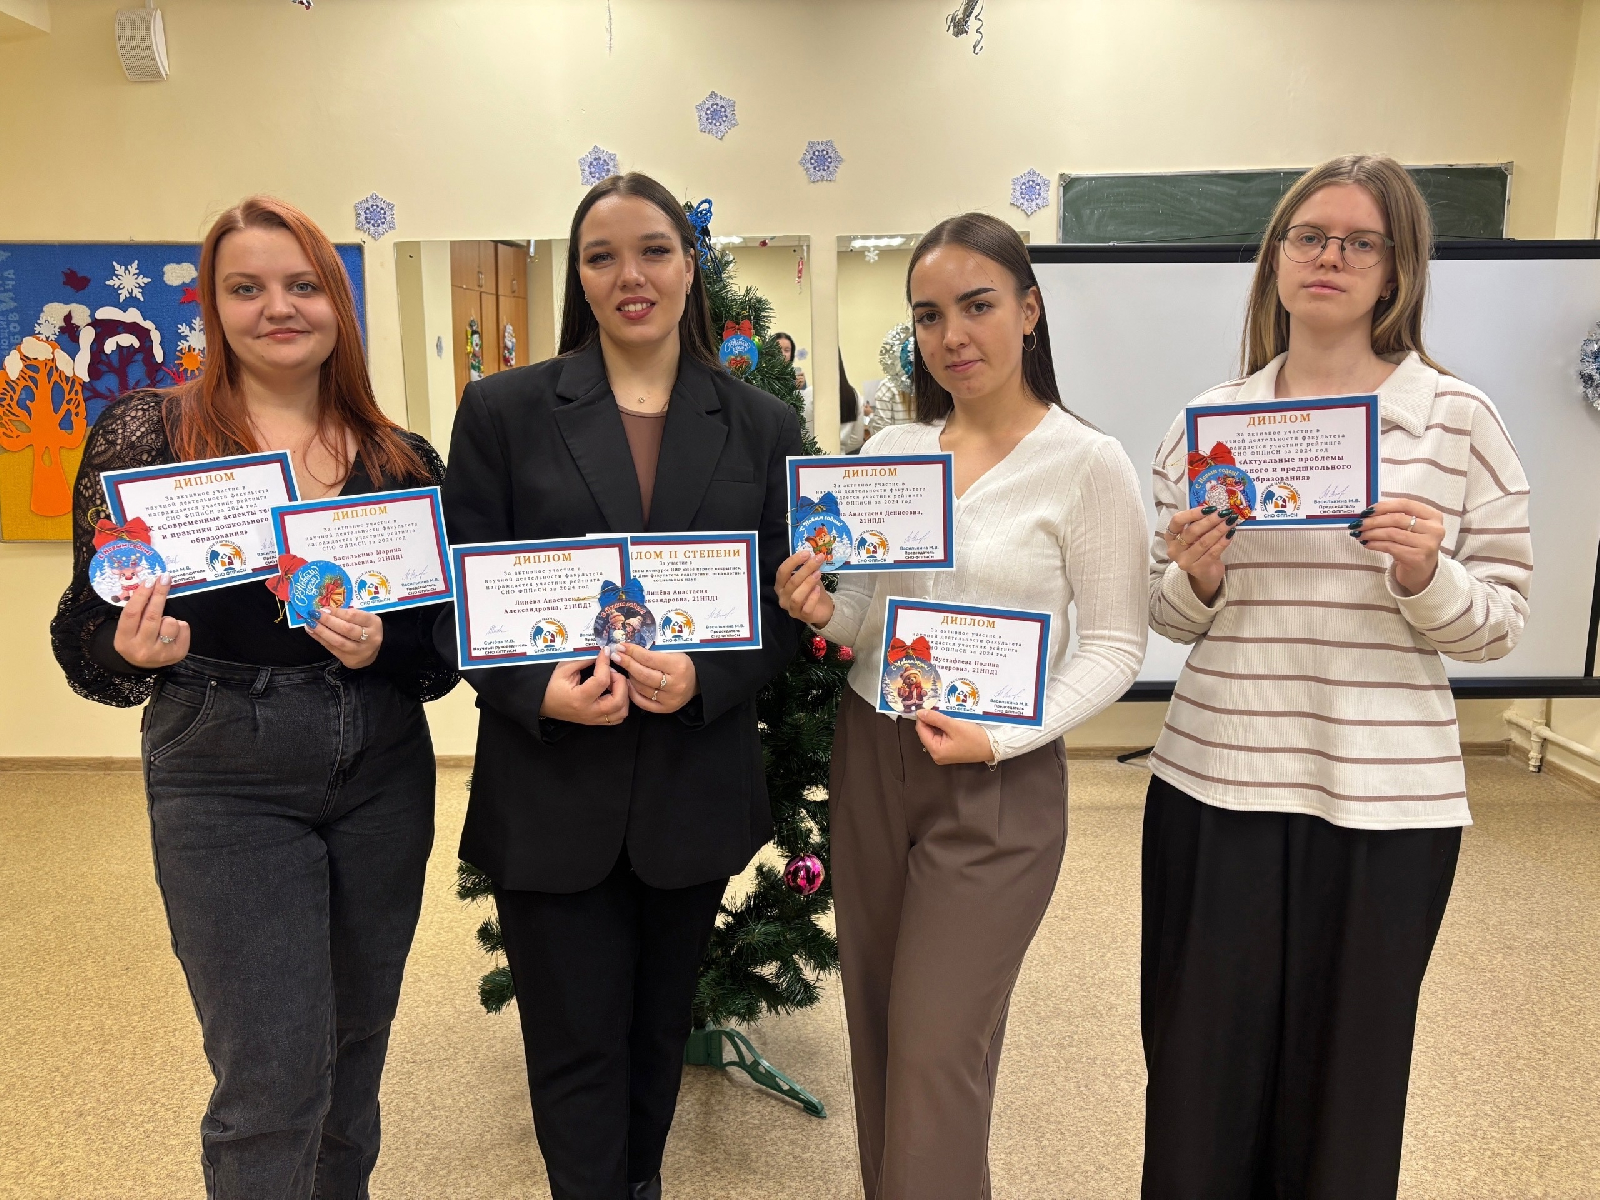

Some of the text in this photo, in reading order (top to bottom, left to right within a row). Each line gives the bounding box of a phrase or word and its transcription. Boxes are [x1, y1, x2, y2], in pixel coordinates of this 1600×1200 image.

[1247, 413, 1310, 428] ДИПЛОМ
[1228, 444, 1266, 452] раждается
[1238, 456, 1344, 466] «Актуальные проблемы
[843, 468, 897, 479] ДИПЛОМ
[1280, 464, 1352, 474] предшкольного
[175, 472, 235, 490] ДИПЛОМ
[333, 506, 387, 522] ДИПЛОМ
[158, 516, 220, 530] «Современные
[223, 511, 256, 520] аспекты
[170, 527, 211, 538] практики
[215, 518, 268, 531] дошкольного
[513, 553, 571, 566] ДИПЛОМ
[631, 551, 663, 560] ЛОМ
[684, 549, 740, 558] СТЕПЕНИ
[941, 616, 995, 628] ДИПЛОМ
